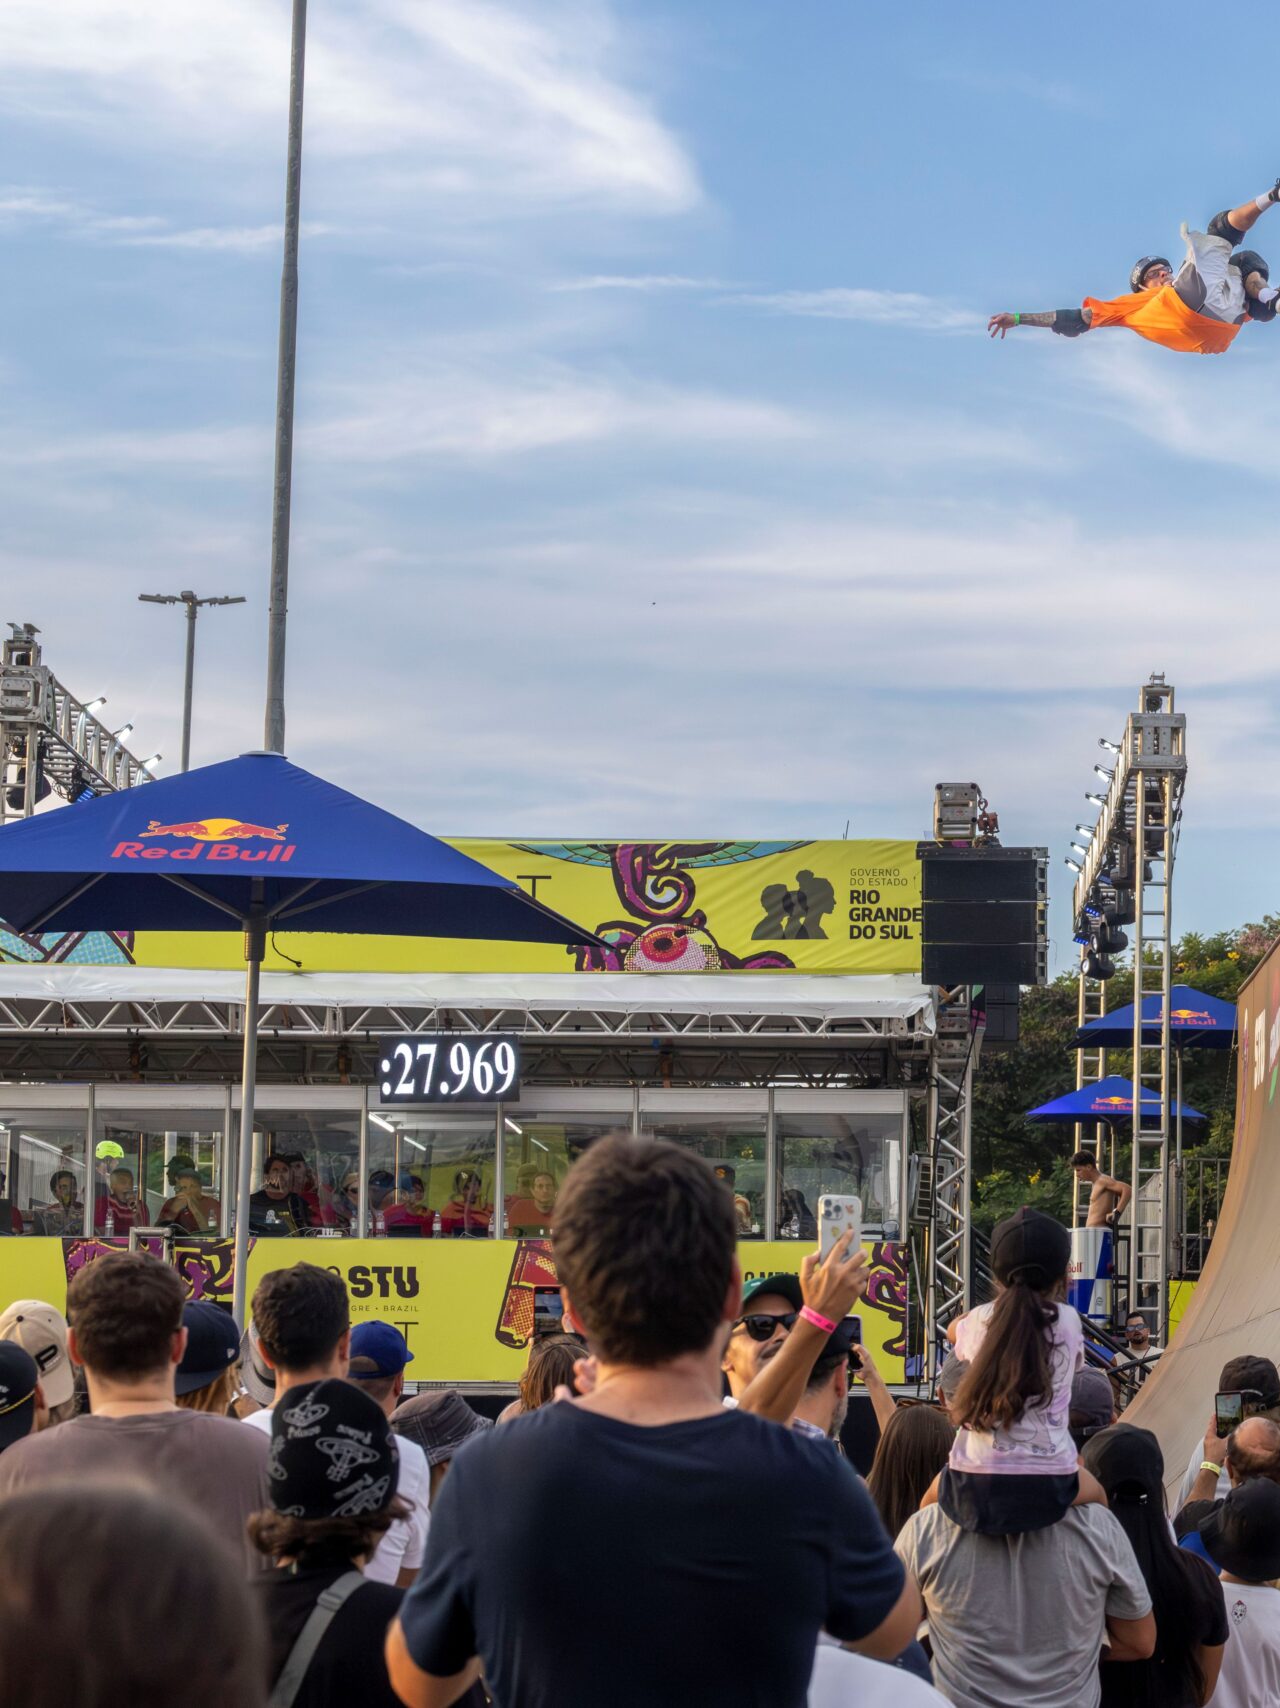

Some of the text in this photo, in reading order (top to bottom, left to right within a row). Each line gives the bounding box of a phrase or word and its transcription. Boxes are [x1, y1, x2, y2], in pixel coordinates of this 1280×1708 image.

[110, 841, 297, 862] Red Bull
[850, 868, 900, 877] GOVERNO
[849, 878, 908, 886] DO ESTADO
[849, 889, 881, 905] RIO
[848, 907, 922, 922] GRANDE
[849, 924, 914, 940] DO SUL
[1254, 1008, 1266, 1091] STU
[381, 1042, 516, 1096] :27.969
[347, 1265, 420, 1299] STU
